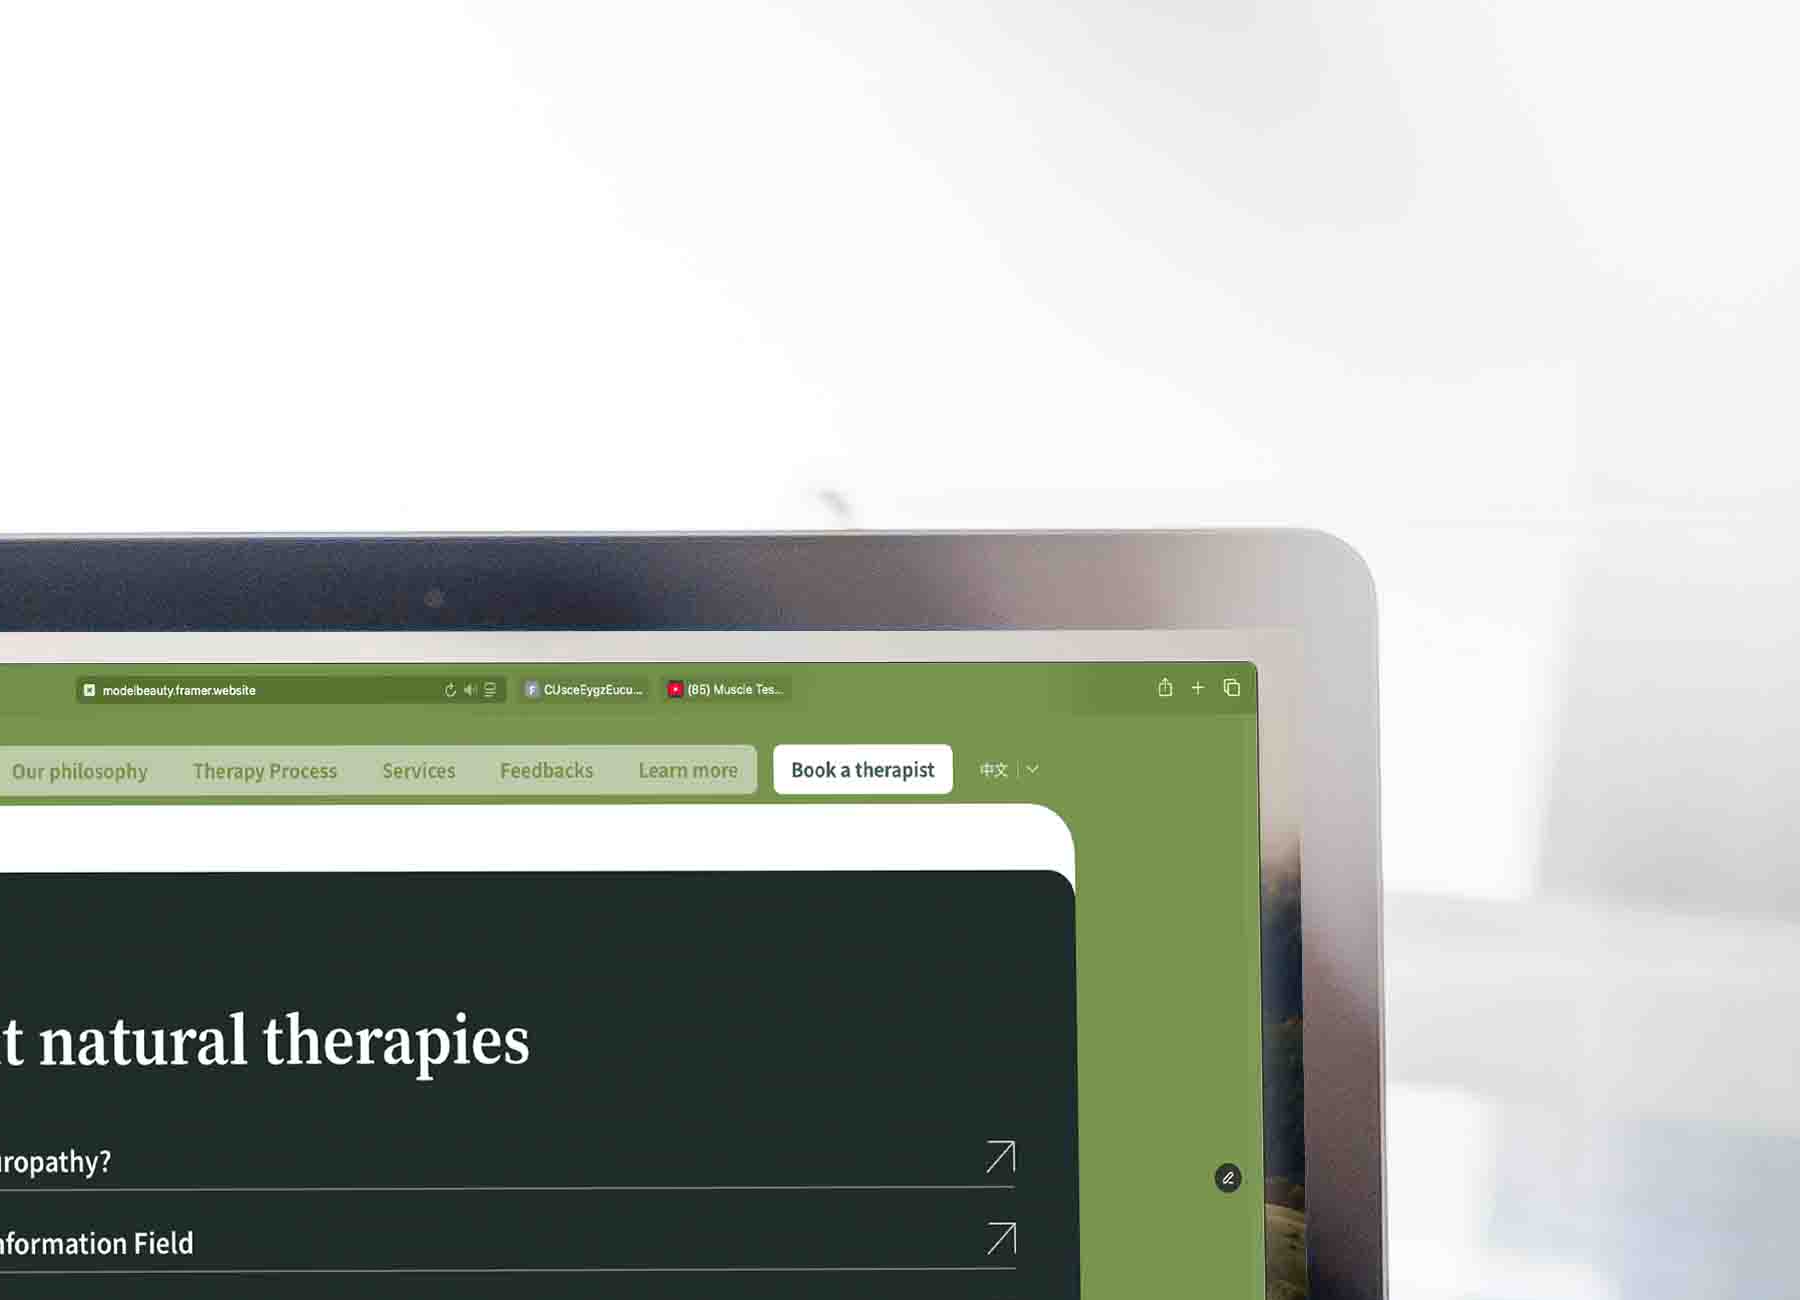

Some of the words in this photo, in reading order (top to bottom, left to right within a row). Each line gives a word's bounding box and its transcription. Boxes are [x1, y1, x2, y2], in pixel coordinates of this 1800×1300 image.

[12, 763, 46, 780] Our
[49, 761, 149, 785] philosophy
[192, 761, 265, 784] Therapy
[269, 762, 337, 780] Process
[383, 761, 456, 780] Services
[500, 760, 594, 780] Feedbacks
[639, 761, 688, 779] Learn
[692, 764, 739, 779] more
[791, 760, 837, 779] Book
[840, 765, 851, 778] a
[855, 760, 935, 783] therapist
[39, 1011, 249, 1066] natural
[262, 1011, 530, 1081] therapies
[135, 1230, 193, 1255] Field
